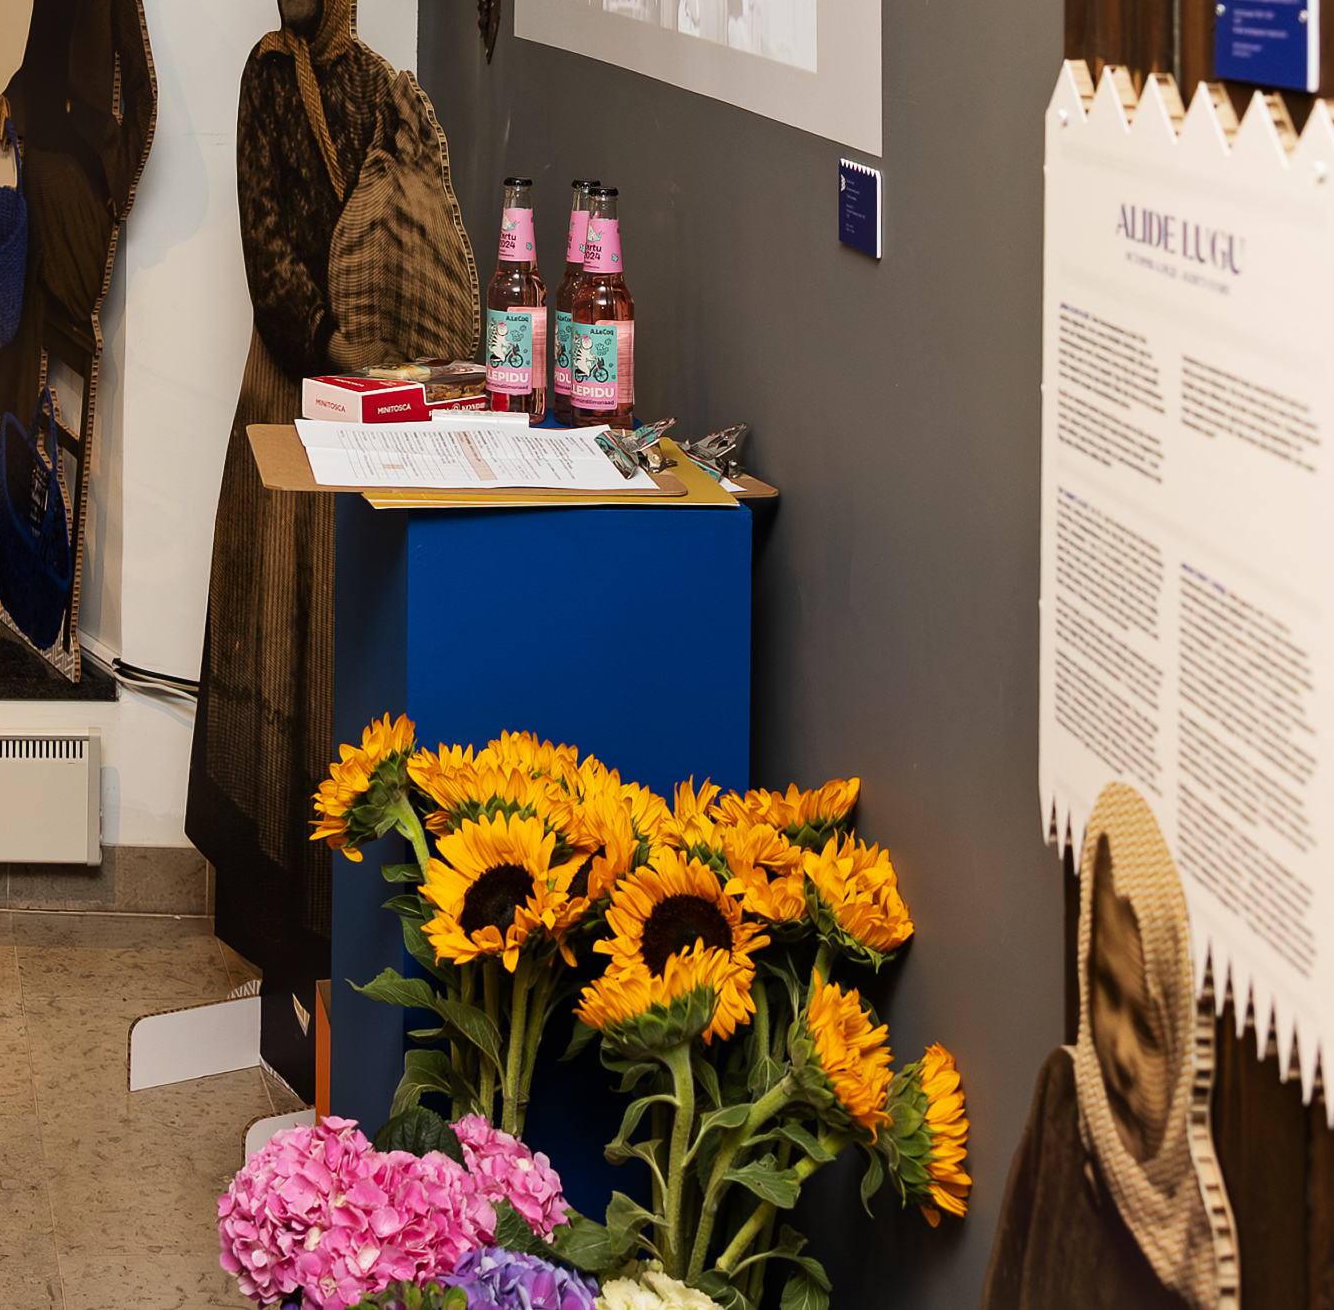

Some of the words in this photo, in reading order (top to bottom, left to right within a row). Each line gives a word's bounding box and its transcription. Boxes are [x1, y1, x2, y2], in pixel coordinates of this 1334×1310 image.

[1116, 203, 1176, 254] ALIDE
[1182, 221, 1245, 274] LUGU
[487, 369, 529, 383] LEPIDU
[571, 384, 615, 398] LEPIDU
[315, 399, 346, 413] MINITOSCA
[377, 403, 412, 415] MINITOSCA
